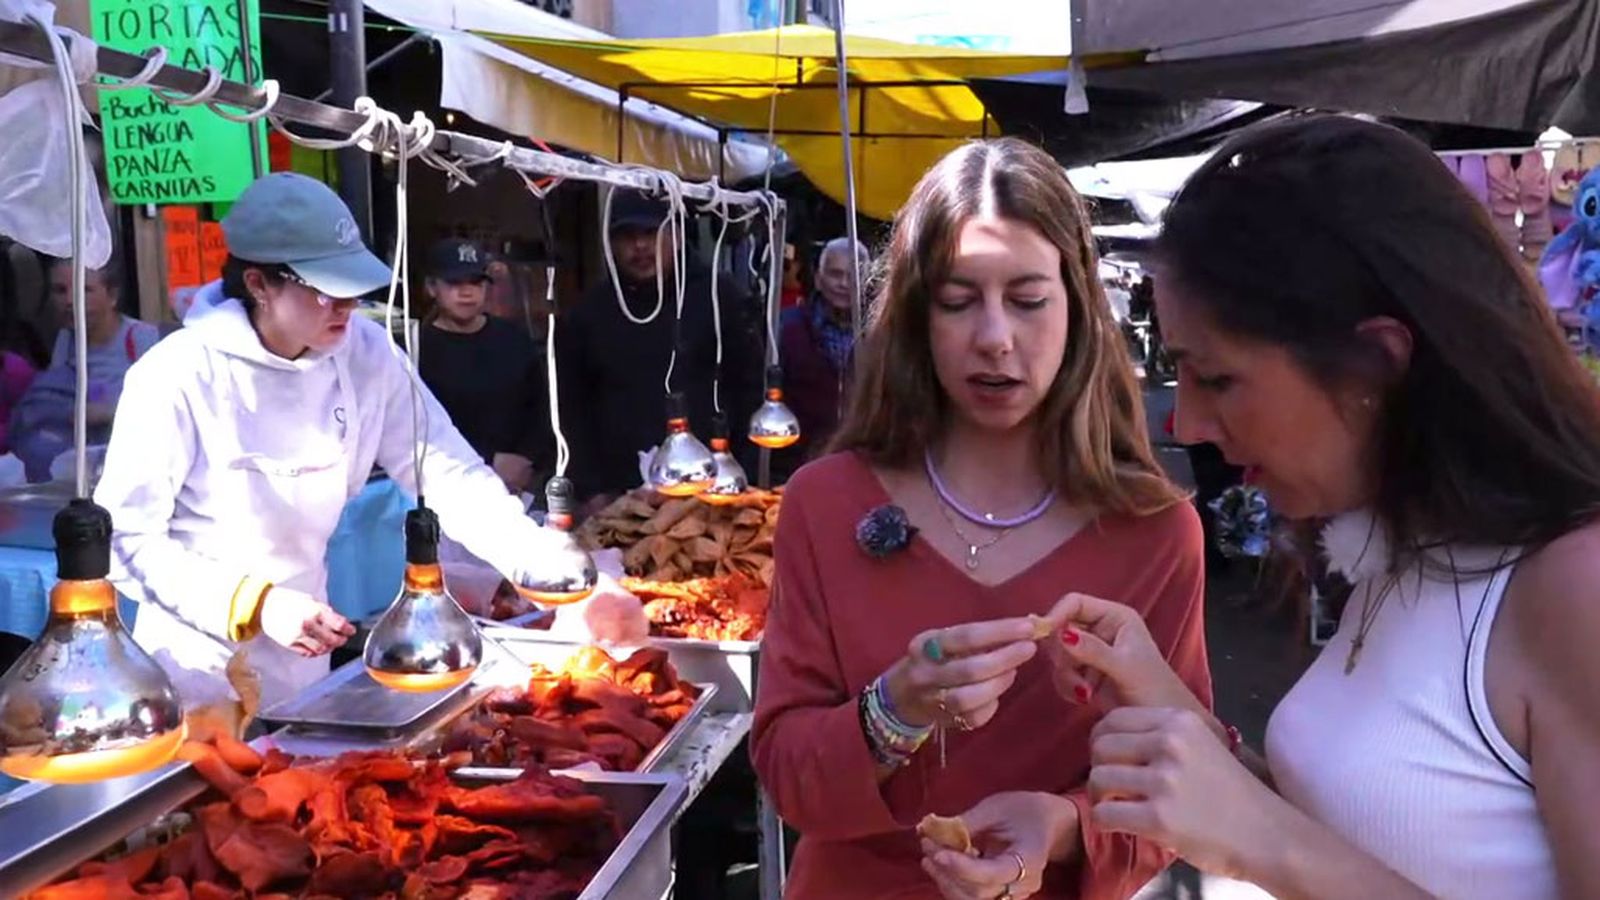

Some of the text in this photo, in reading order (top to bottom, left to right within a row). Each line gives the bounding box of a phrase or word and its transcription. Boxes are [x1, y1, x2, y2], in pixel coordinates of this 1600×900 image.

[101, 3, 242, 41] TORTAS
[113, 120, 194, 150] LENGUA
[113, 148, 193, 178] PANZA
[112, 175, 217, 199] CARNITAS
